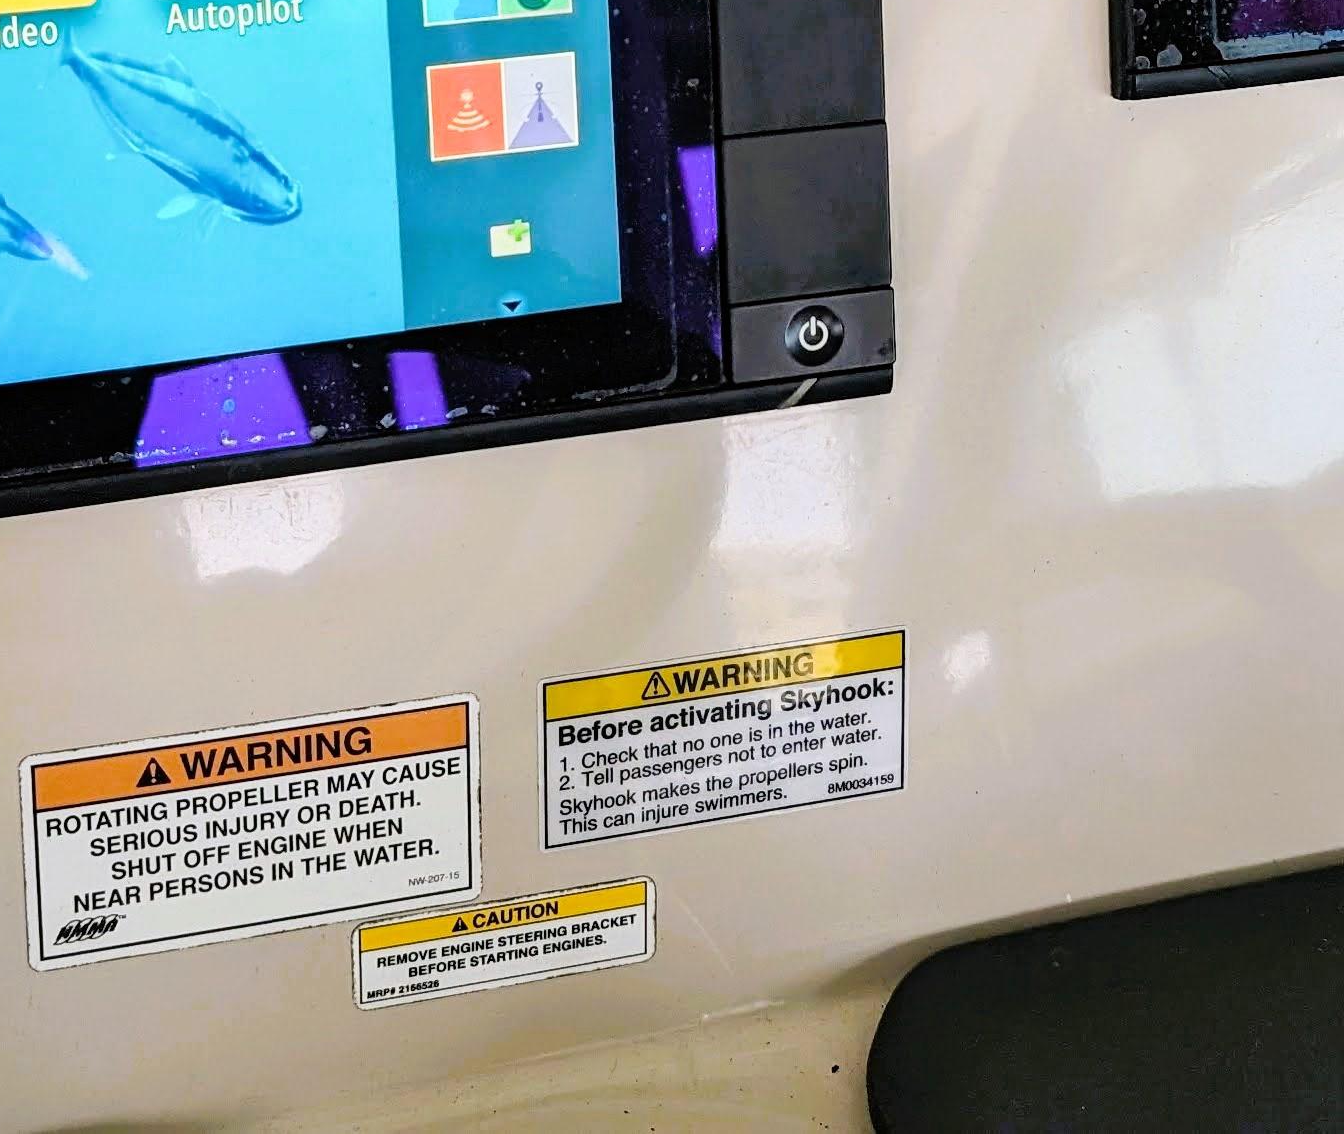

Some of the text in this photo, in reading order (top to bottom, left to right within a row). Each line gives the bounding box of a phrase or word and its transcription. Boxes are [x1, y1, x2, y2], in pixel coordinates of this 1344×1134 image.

[672, 652, 814, 695] WARNING
[558, 678, 894, 747] Before activating Skyhook:
[180, 726, 372, 780] WARNING
[559, 727, 882, 791] 2. Tell passengers not to enter water.
[560, 711, 871, 772] 1. Check that no one is in the water.
[46, 757, 461, 837] ROTATING PROPELLER MAY CAUSE
[559, 753, 868, 817] Skyhook makes the propellers spin.
[559, 788, 787, 836] This can injure swimmers.
[827, 773, 895, 795] 8M0034159
[90, 789, 422, 857] SERIOUS INJURY OR DEATH.
[111, 817, 403, 881] SHUT OFF ENGINE WHEN
[74, 837, 440, 913] NEAR PERSONS IN THE WATER.
[408, 871, 460, 887] NW-207-15
[377, 914, 637, 968] REMOVE ENGINE STEERING BRACKET
[472, 901, 559, 929] CAUTION
[408, 934, 607, 978] BEFORE STARTING ENGINES.
